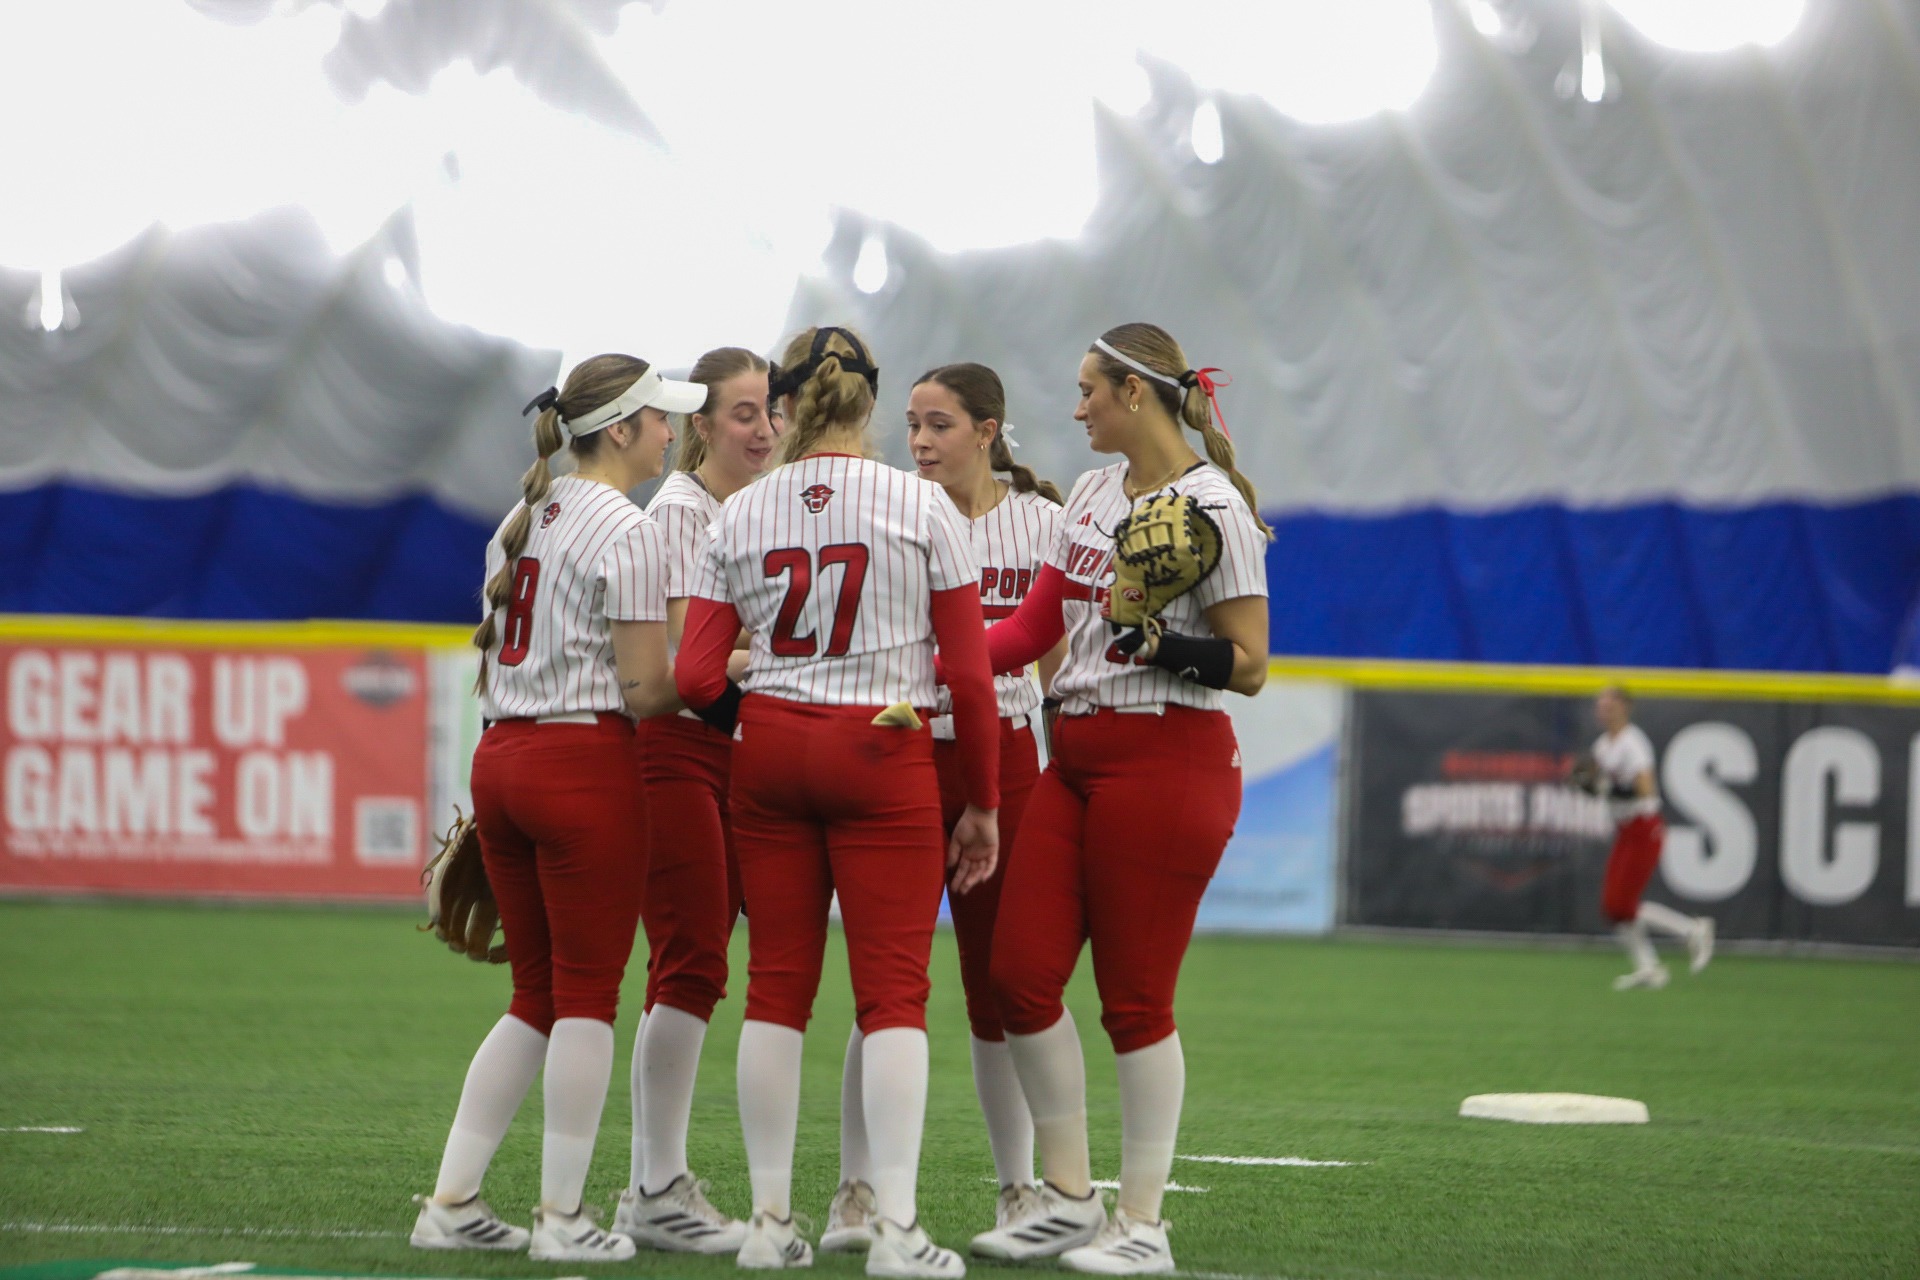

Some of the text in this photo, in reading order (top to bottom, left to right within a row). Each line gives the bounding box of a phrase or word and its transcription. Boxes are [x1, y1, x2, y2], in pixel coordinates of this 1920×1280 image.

[498, 556, 540, 667] 8
[764, 542, 869, 658] 27
[8, 651, 309, 746] GEAR UP
[6, 745, 333, 837] GAME ON
[1661, 721, 1920, 906] SC
